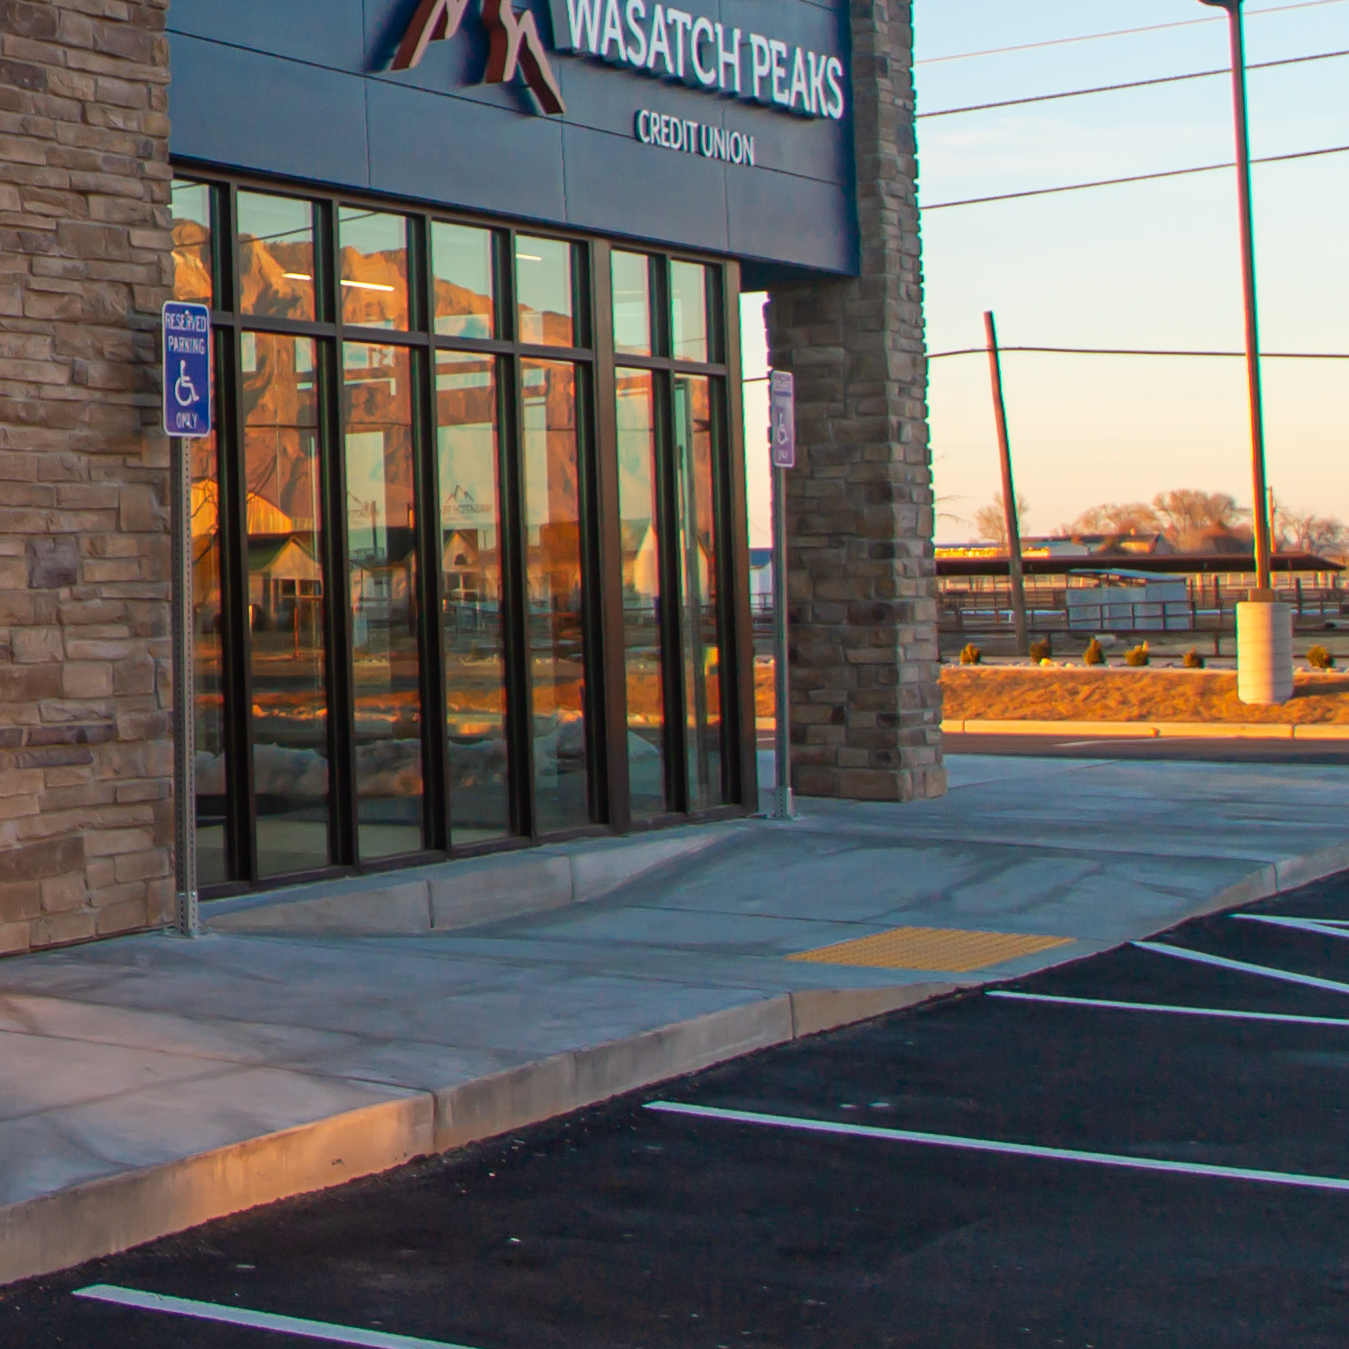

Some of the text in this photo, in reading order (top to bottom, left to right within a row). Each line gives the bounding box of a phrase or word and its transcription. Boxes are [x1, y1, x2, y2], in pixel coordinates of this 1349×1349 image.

[749, 33, 845, 121] PEAKS
[637, 108, 756, 166] CREDIT UNION
[164, 312, 207, 332] RESERVED
[167, 335, 206, 355] PARKING
[175, 412, 199, 429] ONLY
